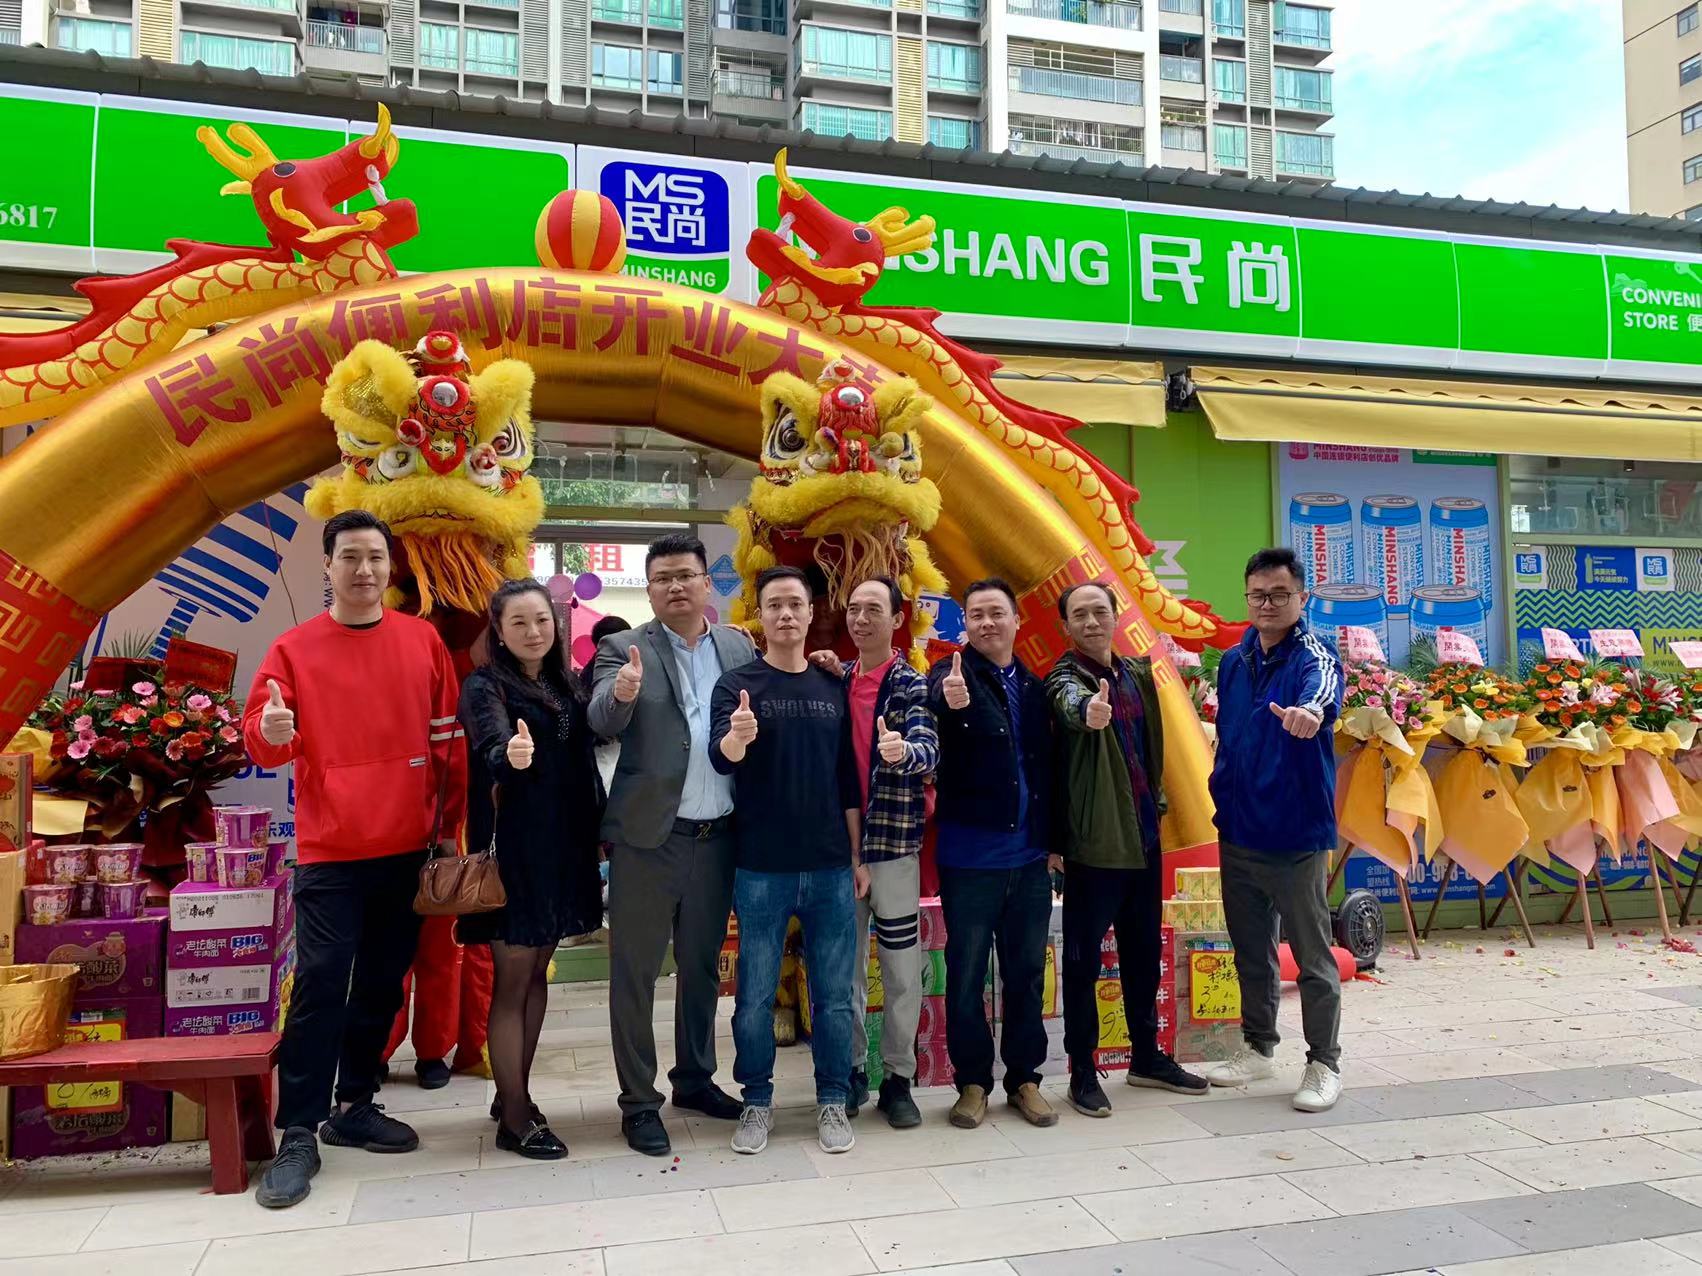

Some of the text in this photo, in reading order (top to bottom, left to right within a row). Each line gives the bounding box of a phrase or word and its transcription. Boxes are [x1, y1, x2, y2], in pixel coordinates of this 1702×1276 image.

[625, 169, 705, 206] MS
[625, 201, 706, 247] 民尚
[1139, 232, 1291, 312] 民尚
[1624, 311, 1679, 331] STORE
[1314, 524, 1327, 584] MINSHA
[1385, 527, 1398, 605] MINSHANG
[1445, 534, 1453, 586] MINSHAN
[1453, 528, 1466, 586] MINSHA
[231, 934, 263, 949] BIG
[227, 1010, 260, 1026] BIG
